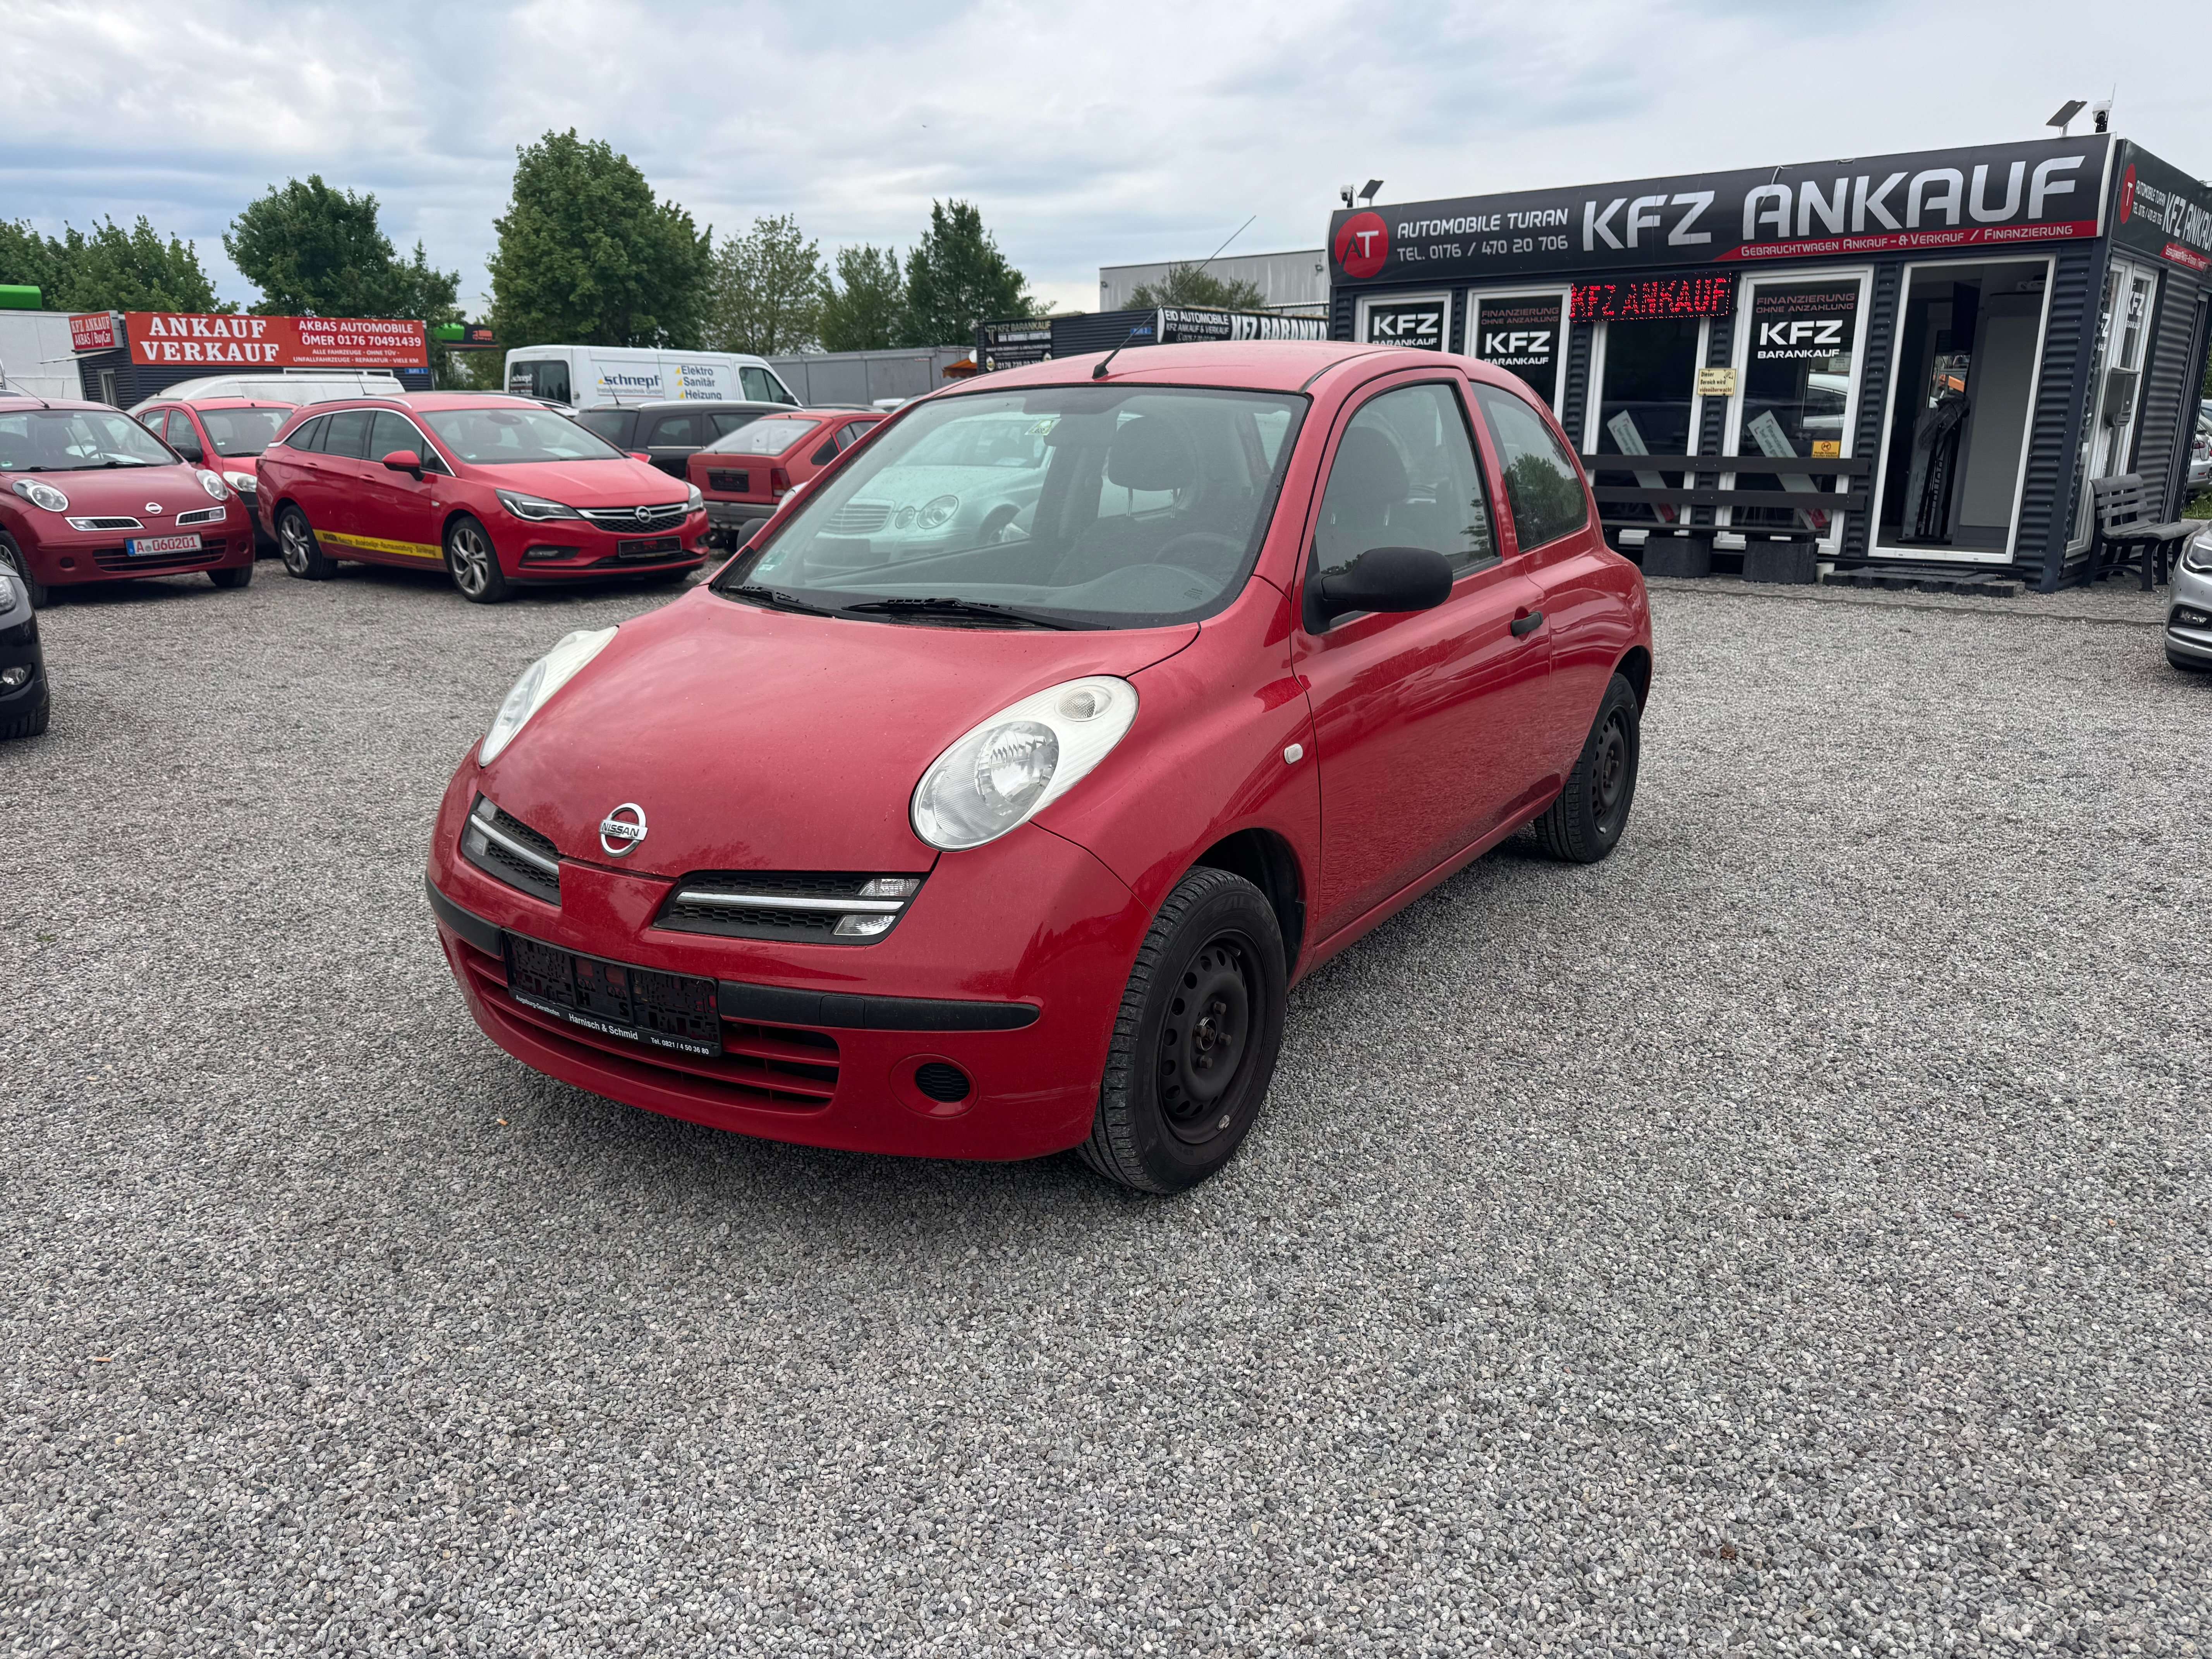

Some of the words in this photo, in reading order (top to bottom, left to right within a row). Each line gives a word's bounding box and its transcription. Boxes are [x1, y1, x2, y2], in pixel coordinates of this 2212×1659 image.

[2135, 180, 2155, 202] AUTOMOBILE
[1583, 191, 1715, 251] KFZ
[1743, 155, 2085, 240] ANKAUF
[2162, 192, 2186, 238] KFZ
[1398, 214, 1501, 239] AUTOMOBILE
[1507, 208, 1568, 229] TURAN
[1397, 247, 1425, 261] TEL.
[1430, 244, 1462, 259] 0176
[1481, 240, 1507, 254] 470
[1513, 238, 1533, 252] 20
[1538, 235, 1568, 251] 706
[1741, 242, 1839, 256] GEBRAUCHTWAGEN
[1843, 238, 1887, 249] ANKAUF
[1910, 233, 1964, 244] VERKAUF
[1984, 225, 2073, 240] FINANZIERUNG
[1570, 283, 1616, 318] KFZ
[1622, 278, 1727, 315] ANKAUF
[1757, 293, 1855, 305] FINANZIERUNG
[1482, 307, 1560, 318] FINANZIERUNG
[1788, 303, 1854, 312] ANZAHLUNG
[70, 320, 84, 333] KFZ
[85, 316, 110, 331] ANKAUF
[1165, 310, 1178, 321] EID
[1181, 311, 1229, 325] AUTOMOBILE
[1373, 313, 1439, 336] KFZ
[1506, 316, 1559, 324] ANZAHLUNG
[149, 317, 266, 338] ANKAUF
[299, 320, 337, 331] AKBAS
[340, 322, 414, 333] AUTOMOBILE
[1166, 323, 1178, 331] KFZ
[1178, 324, 1199, 333] ANKAUF
[1205, 326, 1229, 335] VERKAUF
[1230, 315, 1257, 340] KFZ
[1260, 317, 1329, 340] BARANKA
[1760, 320, 1843, 345] KFZ
[74, 332, 91, 346] AKBAS
[94, 331, 111, 346] BuyCar
[302, 332, 335, 345] ÖMER
[337, 335, 366, 345] 0176
[368, 336, 421, 347] 70491439
[1485, 331, 1551, 354] KFZ
[140, 341, 279, 362] VERKAUF
[1757, 349, 1839, 359] BARANKAUF
[681, 366, 713, 376] Elektro
[605, 374, 661, 388] schnepf
[684, 376, 715, 387] Sanitär
[685, 390, 722, 400] Heizung
[137, 541, 144, 552] A
[152, 537, 197, 551] 060201
[601, 823, 640, 837] NISSAN
[569, 1013, 600, 1030] Harnisch
[601, 1024, 608, 1032] &
[609, 1026, 638, 1040] Schmid
